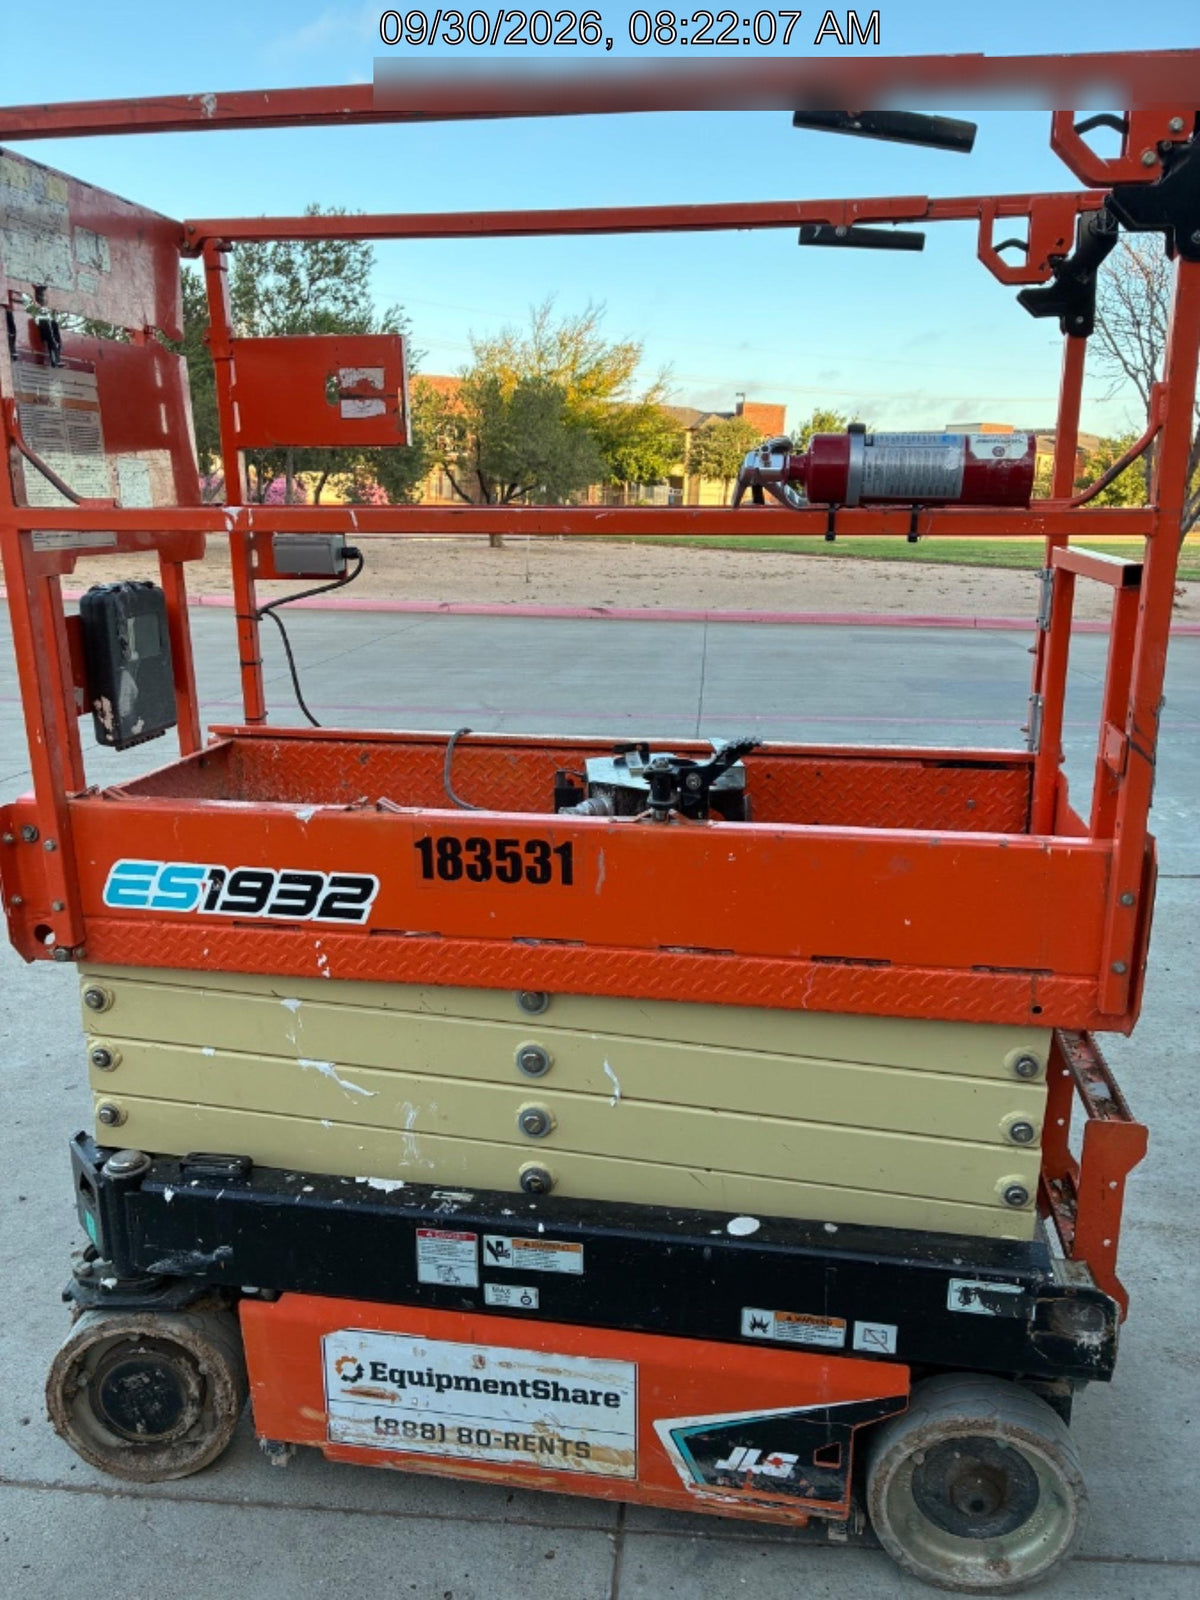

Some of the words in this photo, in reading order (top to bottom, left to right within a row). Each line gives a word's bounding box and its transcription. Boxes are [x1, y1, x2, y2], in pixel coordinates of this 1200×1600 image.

[414, 836, 574, 886] 183531
[105, 860, 377, 922] ES1932
[369, 1361, 621, 1408] EquipmentShare
[373, 1415, 446, 1443] (888)
[456, 1426, 591, 1459] 80-RENTS
